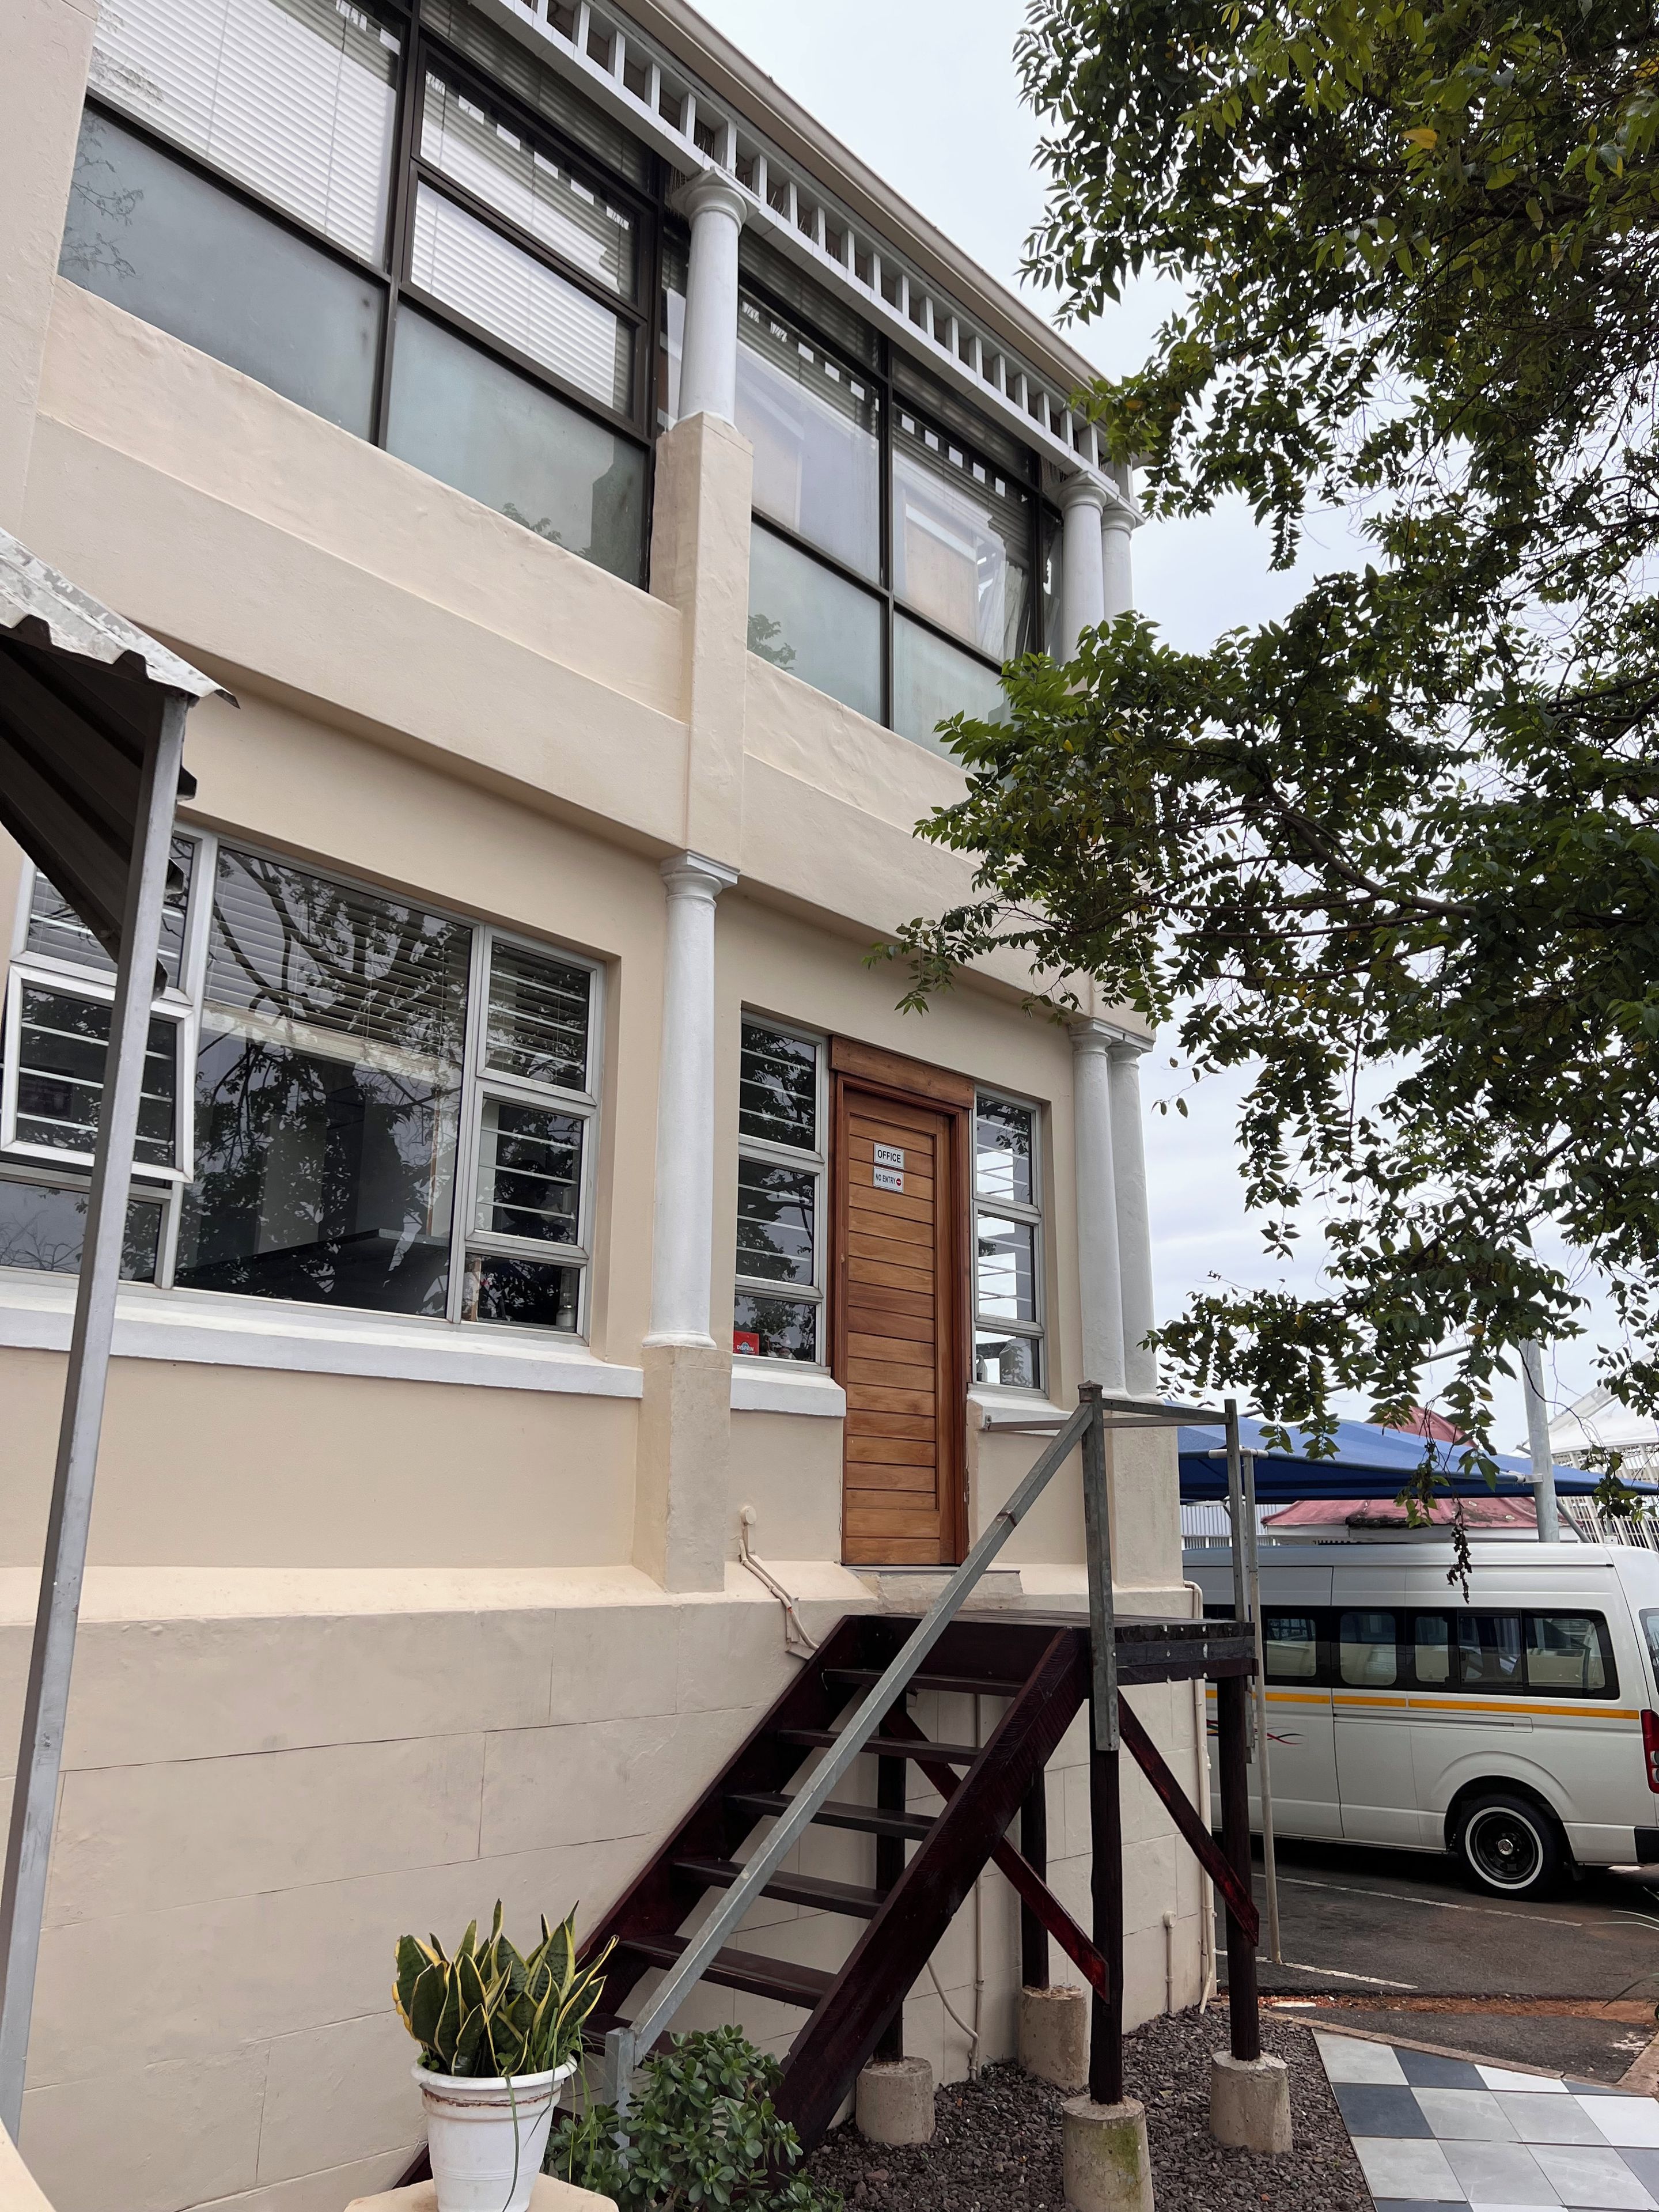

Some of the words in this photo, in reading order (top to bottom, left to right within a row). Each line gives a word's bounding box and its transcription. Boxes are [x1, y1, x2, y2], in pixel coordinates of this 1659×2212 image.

[877, 1149, 901, 1163] OFFICE
[876, 1173, 881, 1181] NO
[882, 1175, 895, 1184] ENTRY
